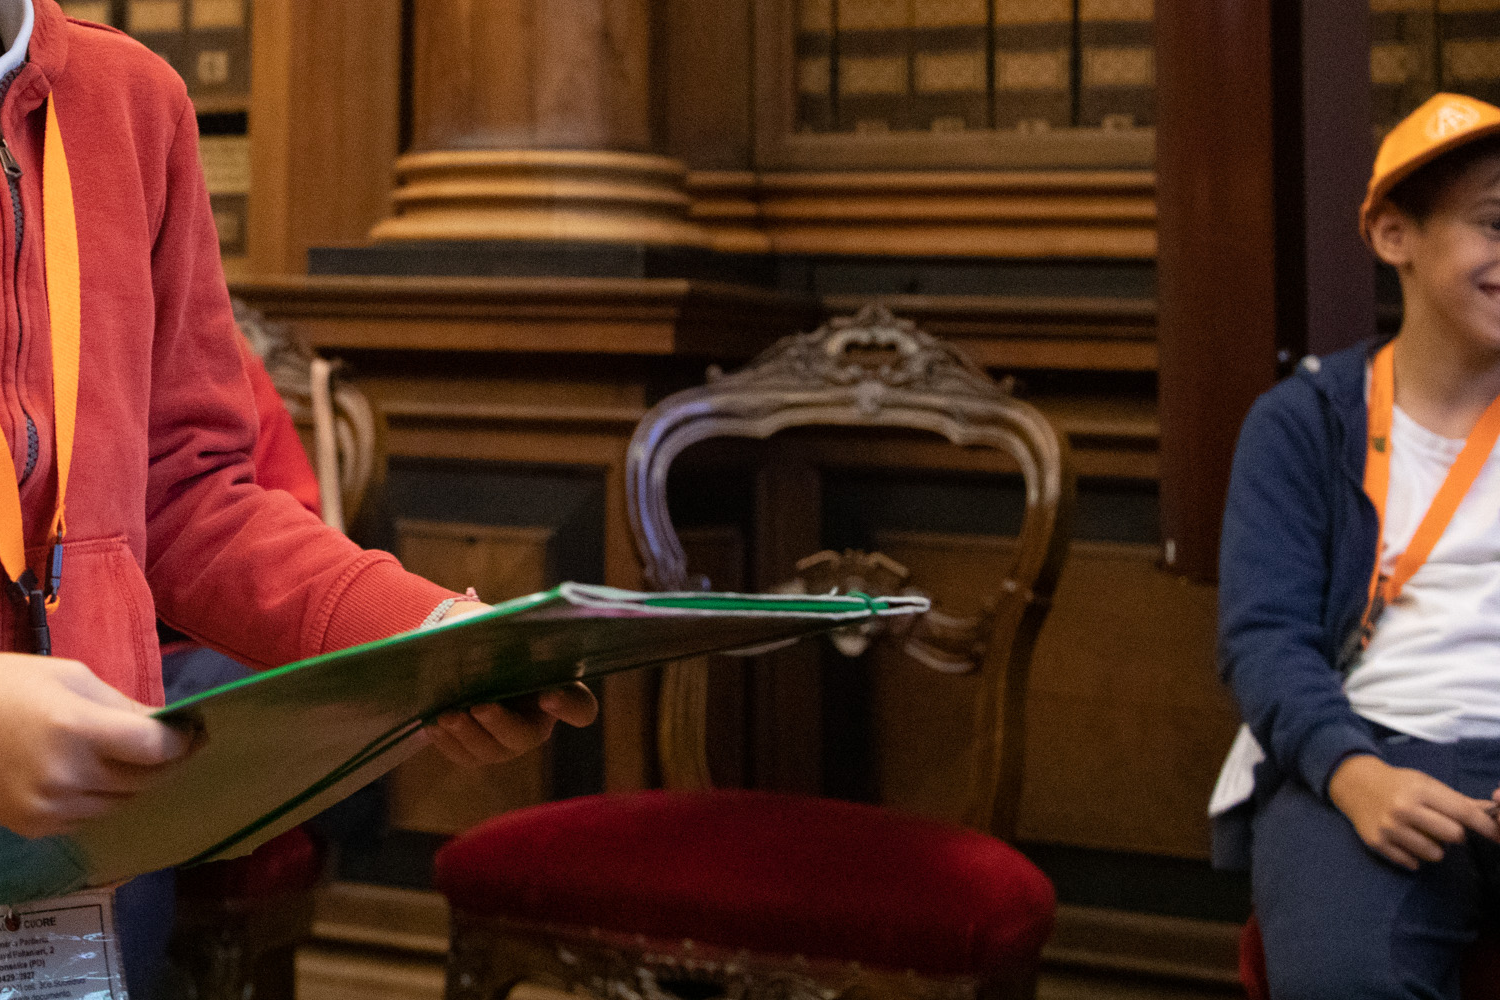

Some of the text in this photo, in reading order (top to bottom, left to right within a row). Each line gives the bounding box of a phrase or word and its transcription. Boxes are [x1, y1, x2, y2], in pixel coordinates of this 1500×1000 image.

[24, 917, 56, 929] CUORE
[49, 945, 55, 954] 2
[29, 958, 46, 969] (PD)
